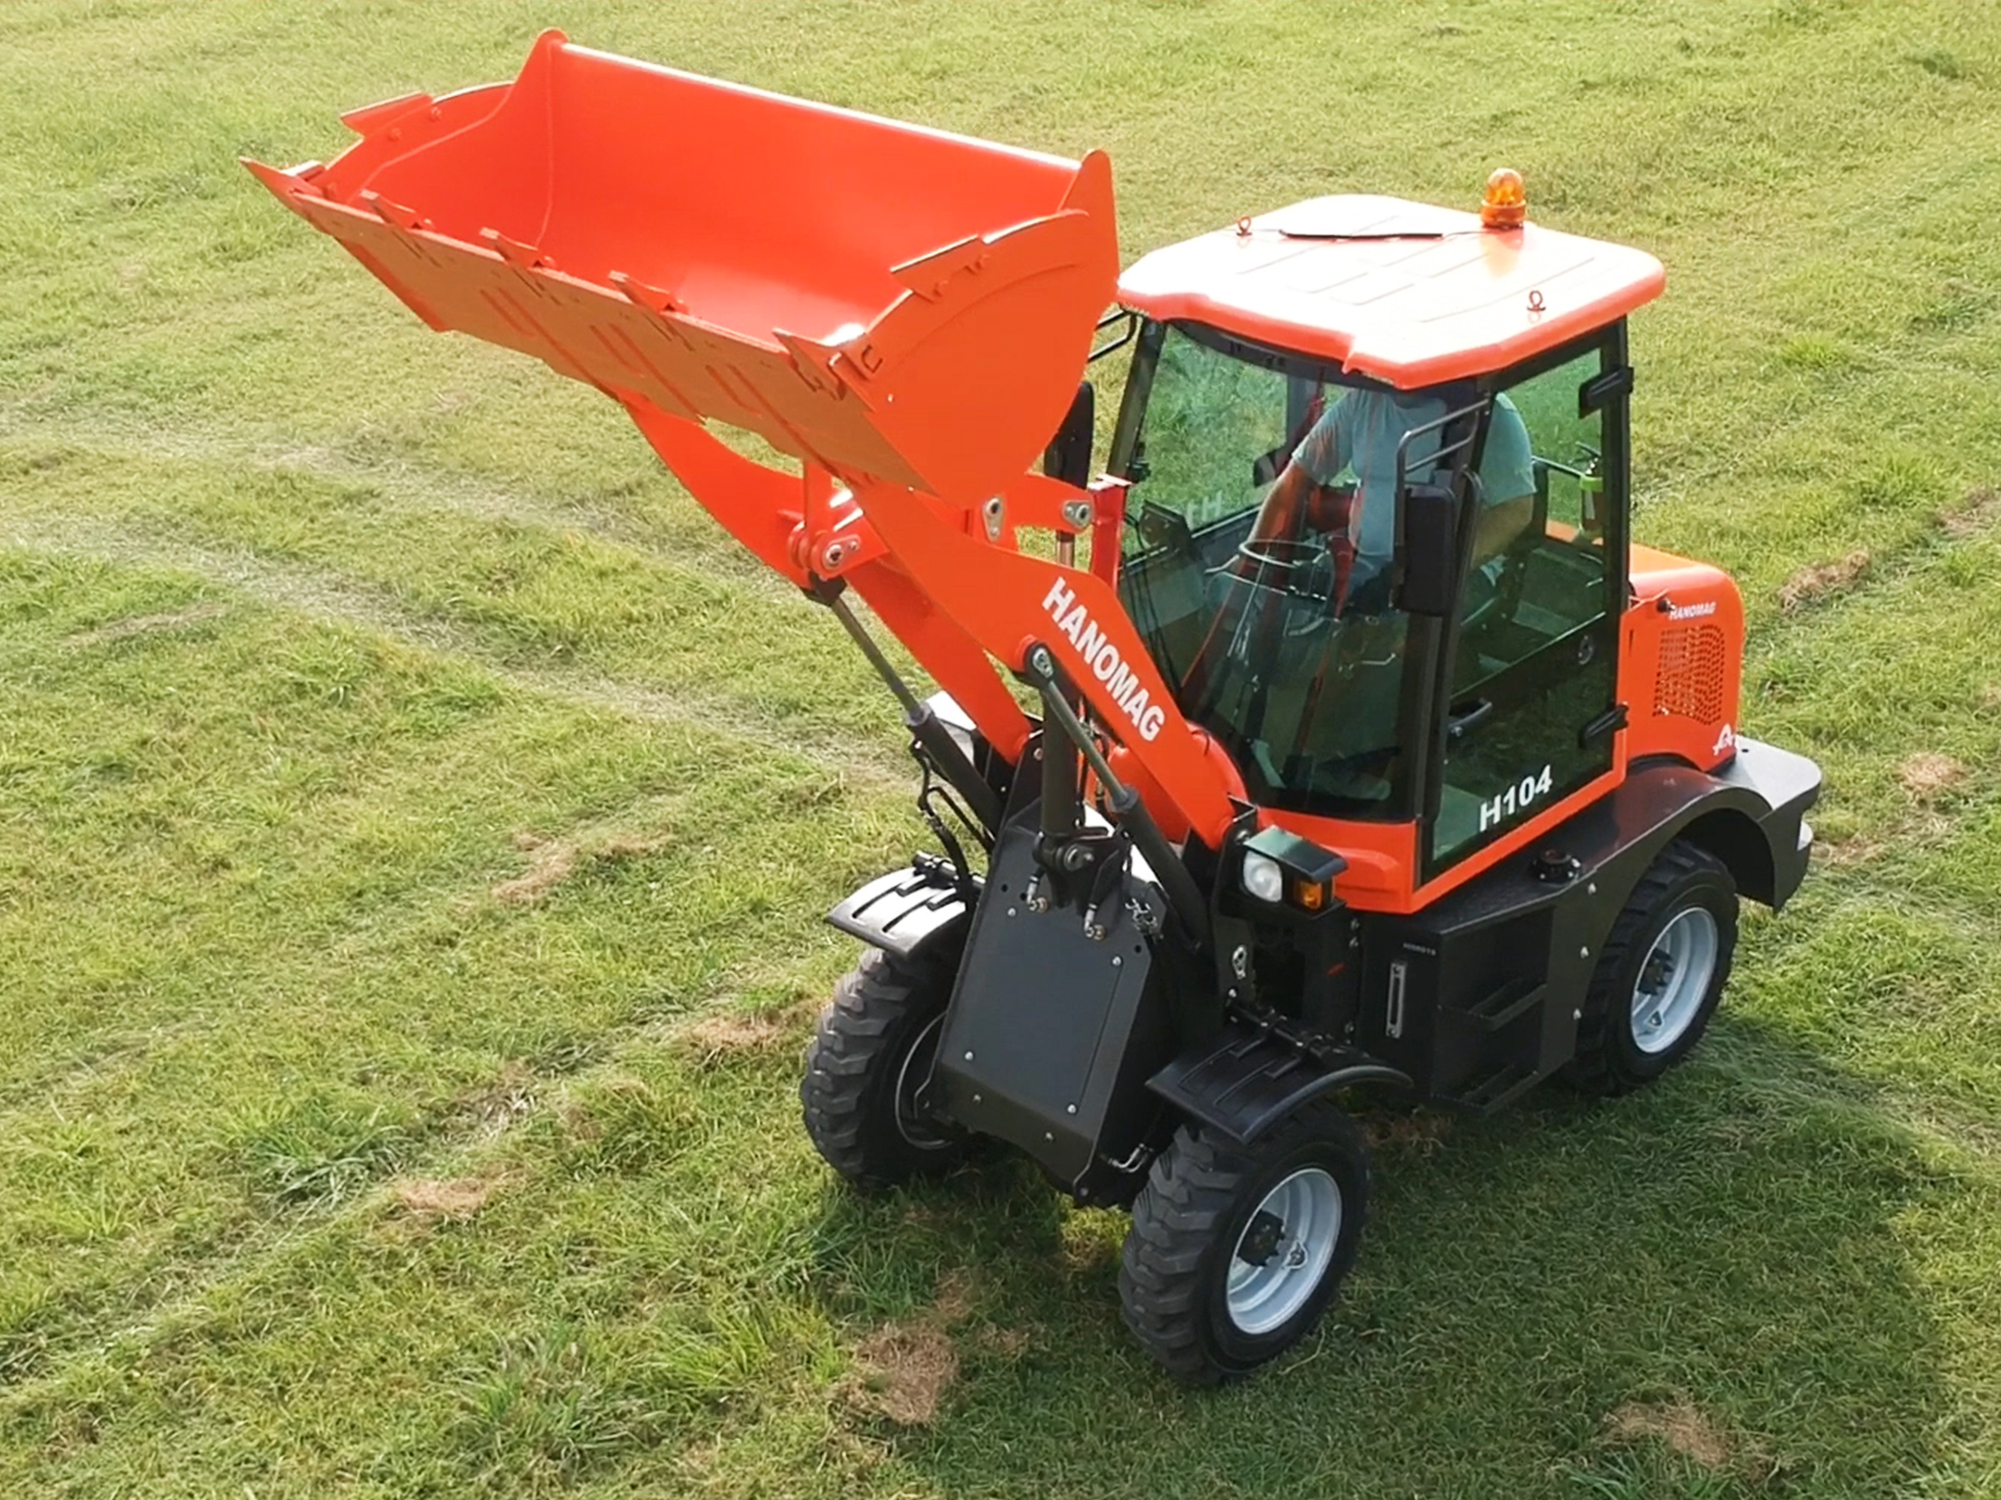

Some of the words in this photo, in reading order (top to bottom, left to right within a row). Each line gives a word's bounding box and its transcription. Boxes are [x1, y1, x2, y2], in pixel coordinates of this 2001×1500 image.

[1669, 602, 1716, 620] HANOMAG
[1042, 577, 1165, 741] HANOMAG
[1480, 764, 1553, 832] H104
